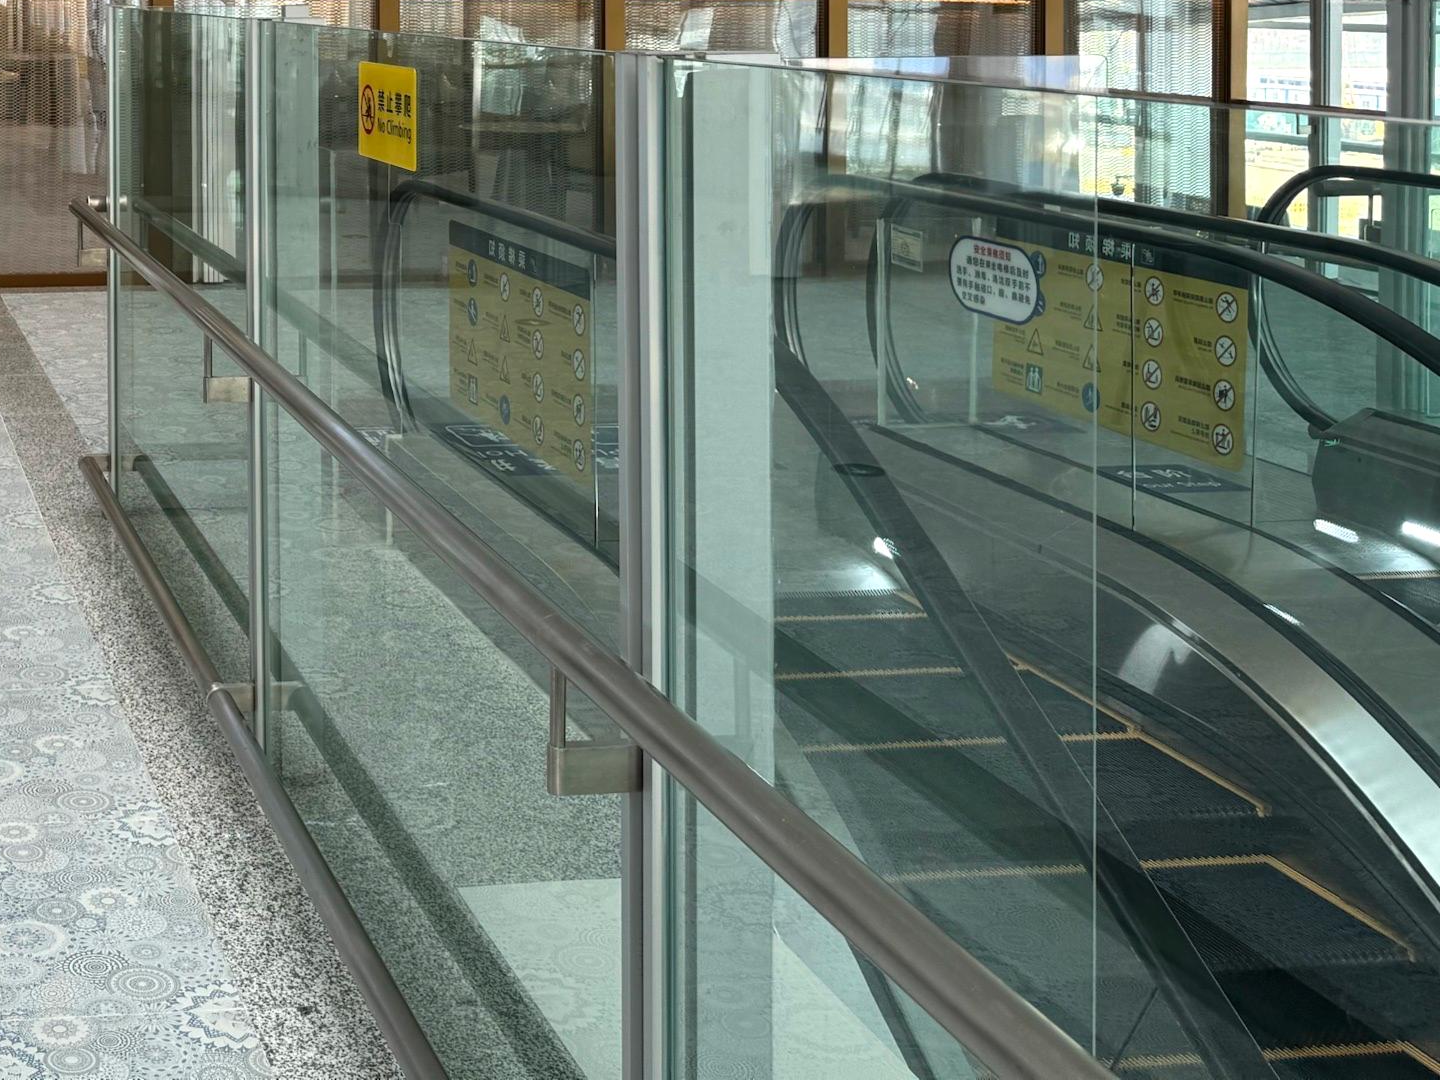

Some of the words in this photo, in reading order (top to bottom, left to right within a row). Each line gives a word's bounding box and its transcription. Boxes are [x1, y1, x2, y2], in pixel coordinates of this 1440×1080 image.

[377, 89, 412, 119] 禁止攀爬
[377, 118, 386, 135] No
[387, 119, 412, 144] Climbing
